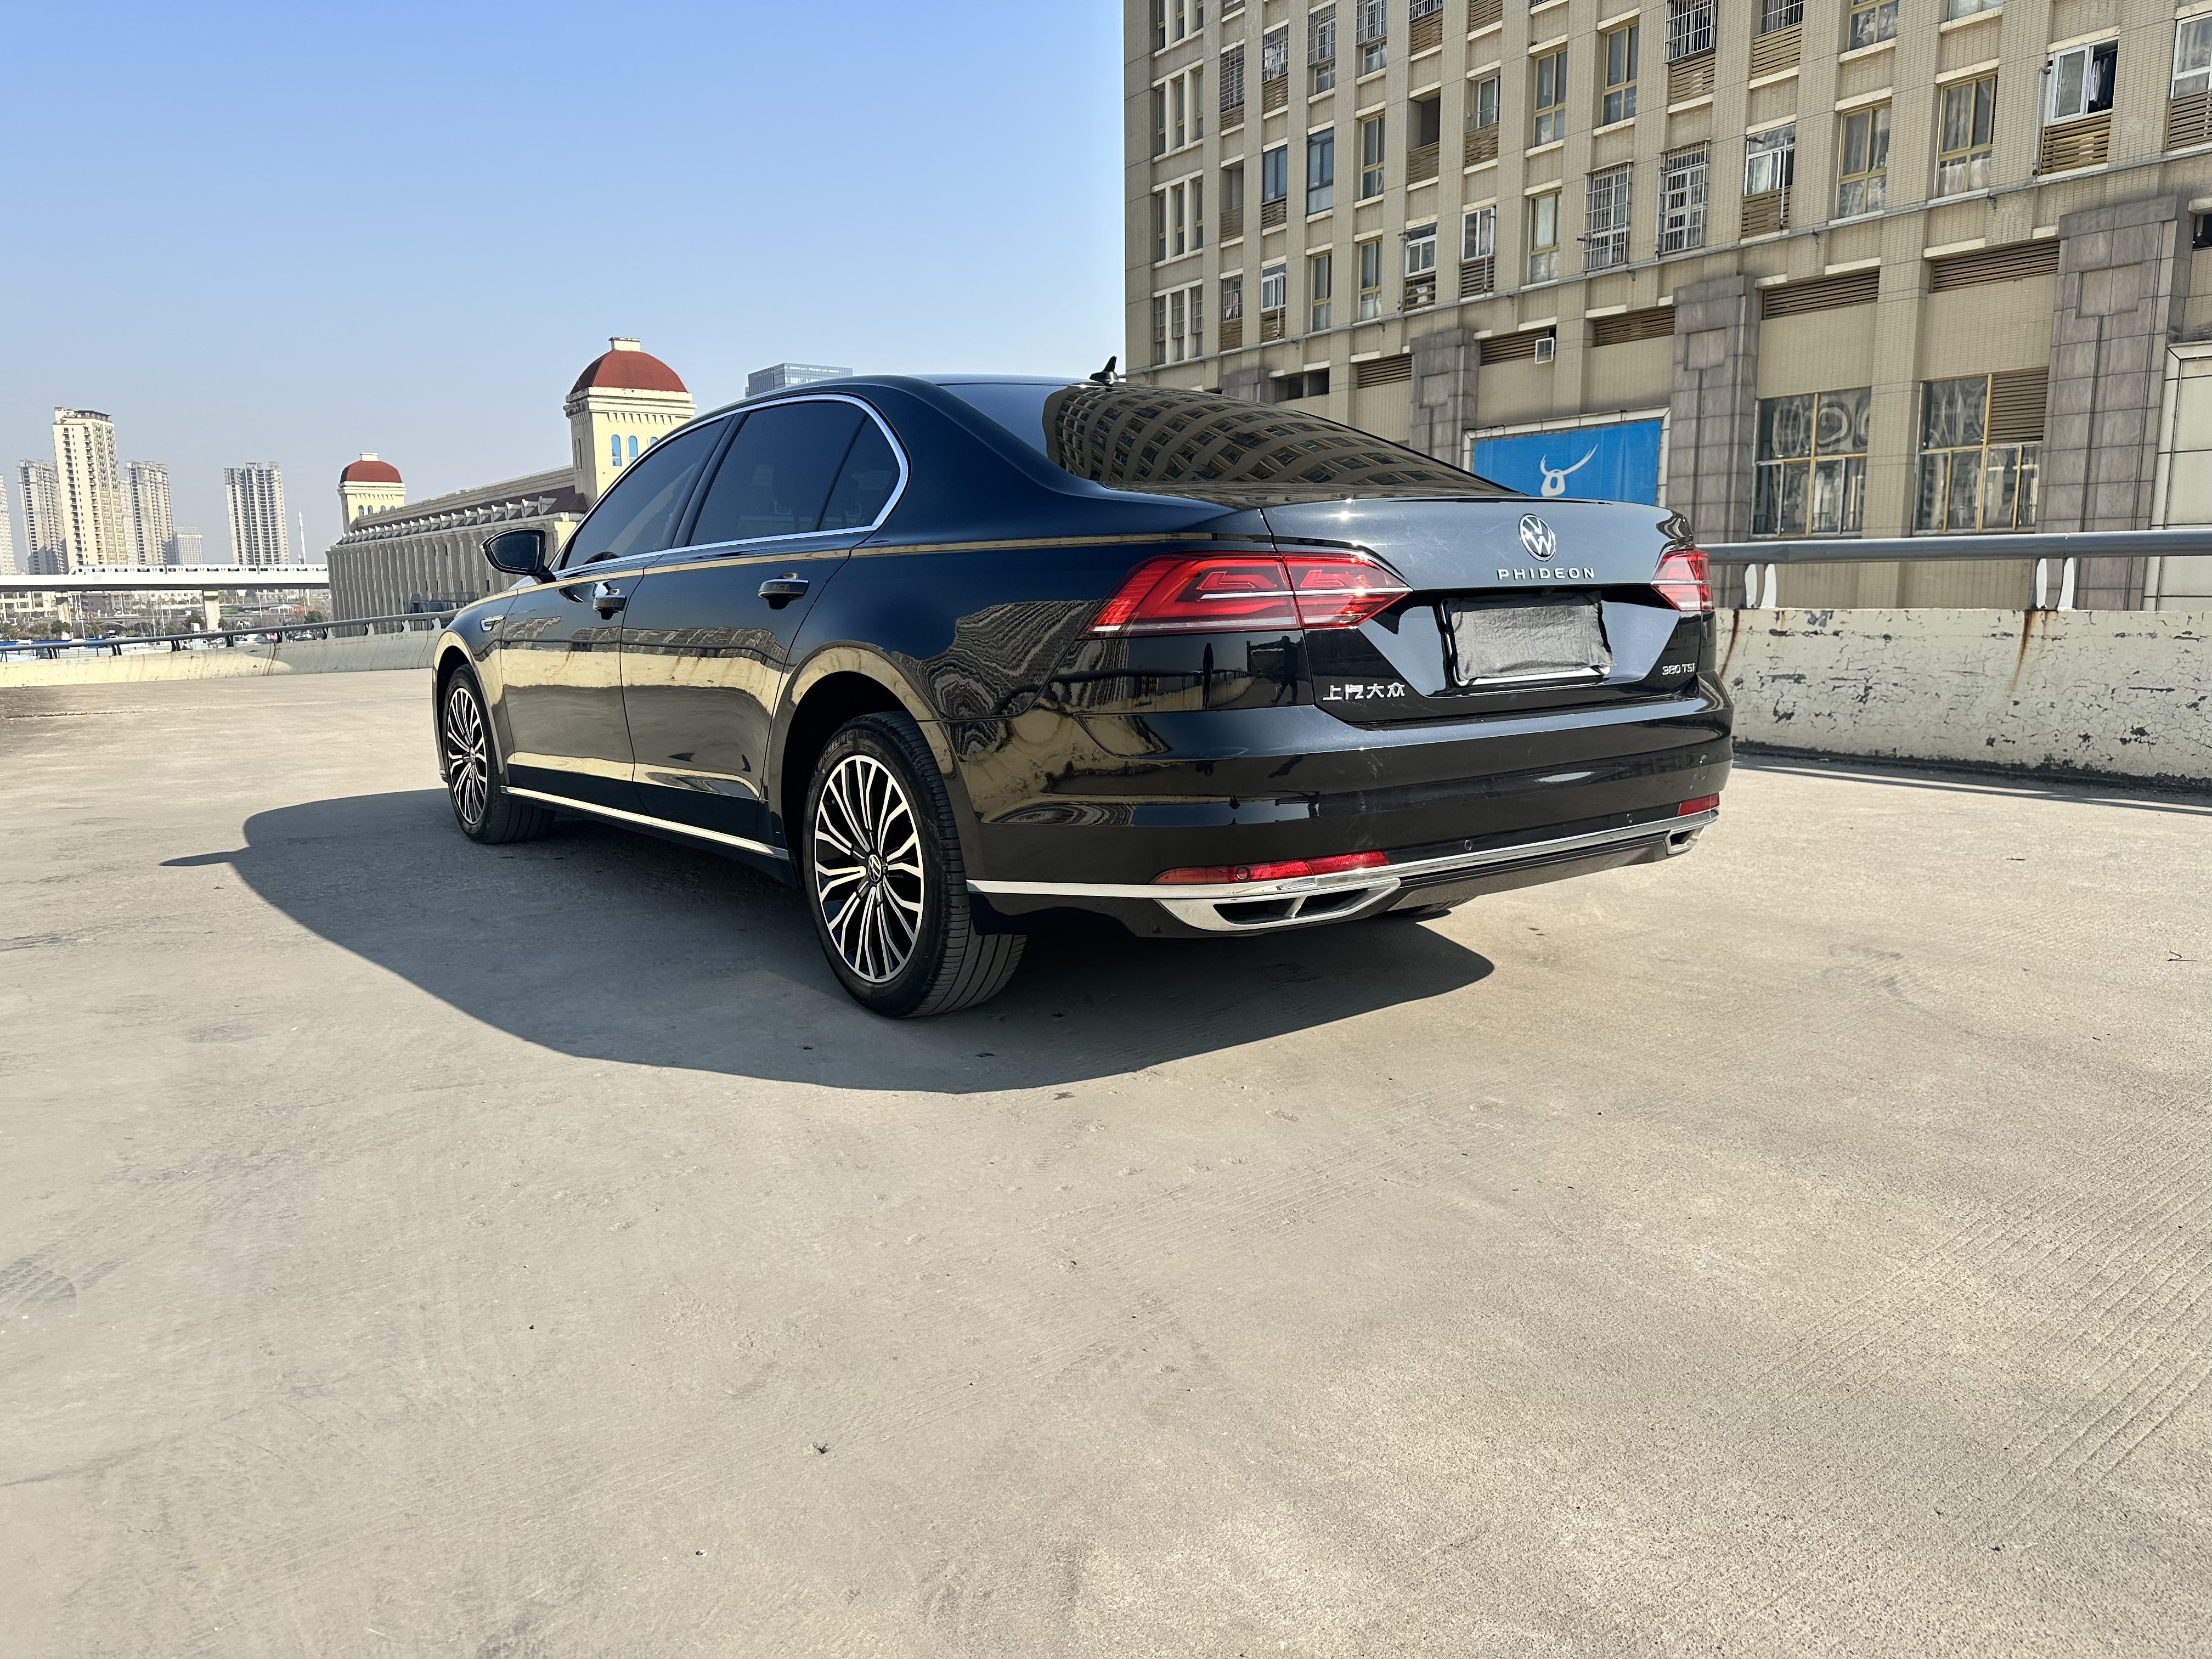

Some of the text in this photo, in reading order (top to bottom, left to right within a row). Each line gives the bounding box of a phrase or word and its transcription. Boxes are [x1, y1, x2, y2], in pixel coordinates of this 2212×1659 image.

[1497, 567, 1595, 580] PHIDEON
[1662, 664, 1681, 675] 380
[1322, 682, 1406, 701] 上汽大众
[817, 733, 847, 770] MICHELIN
